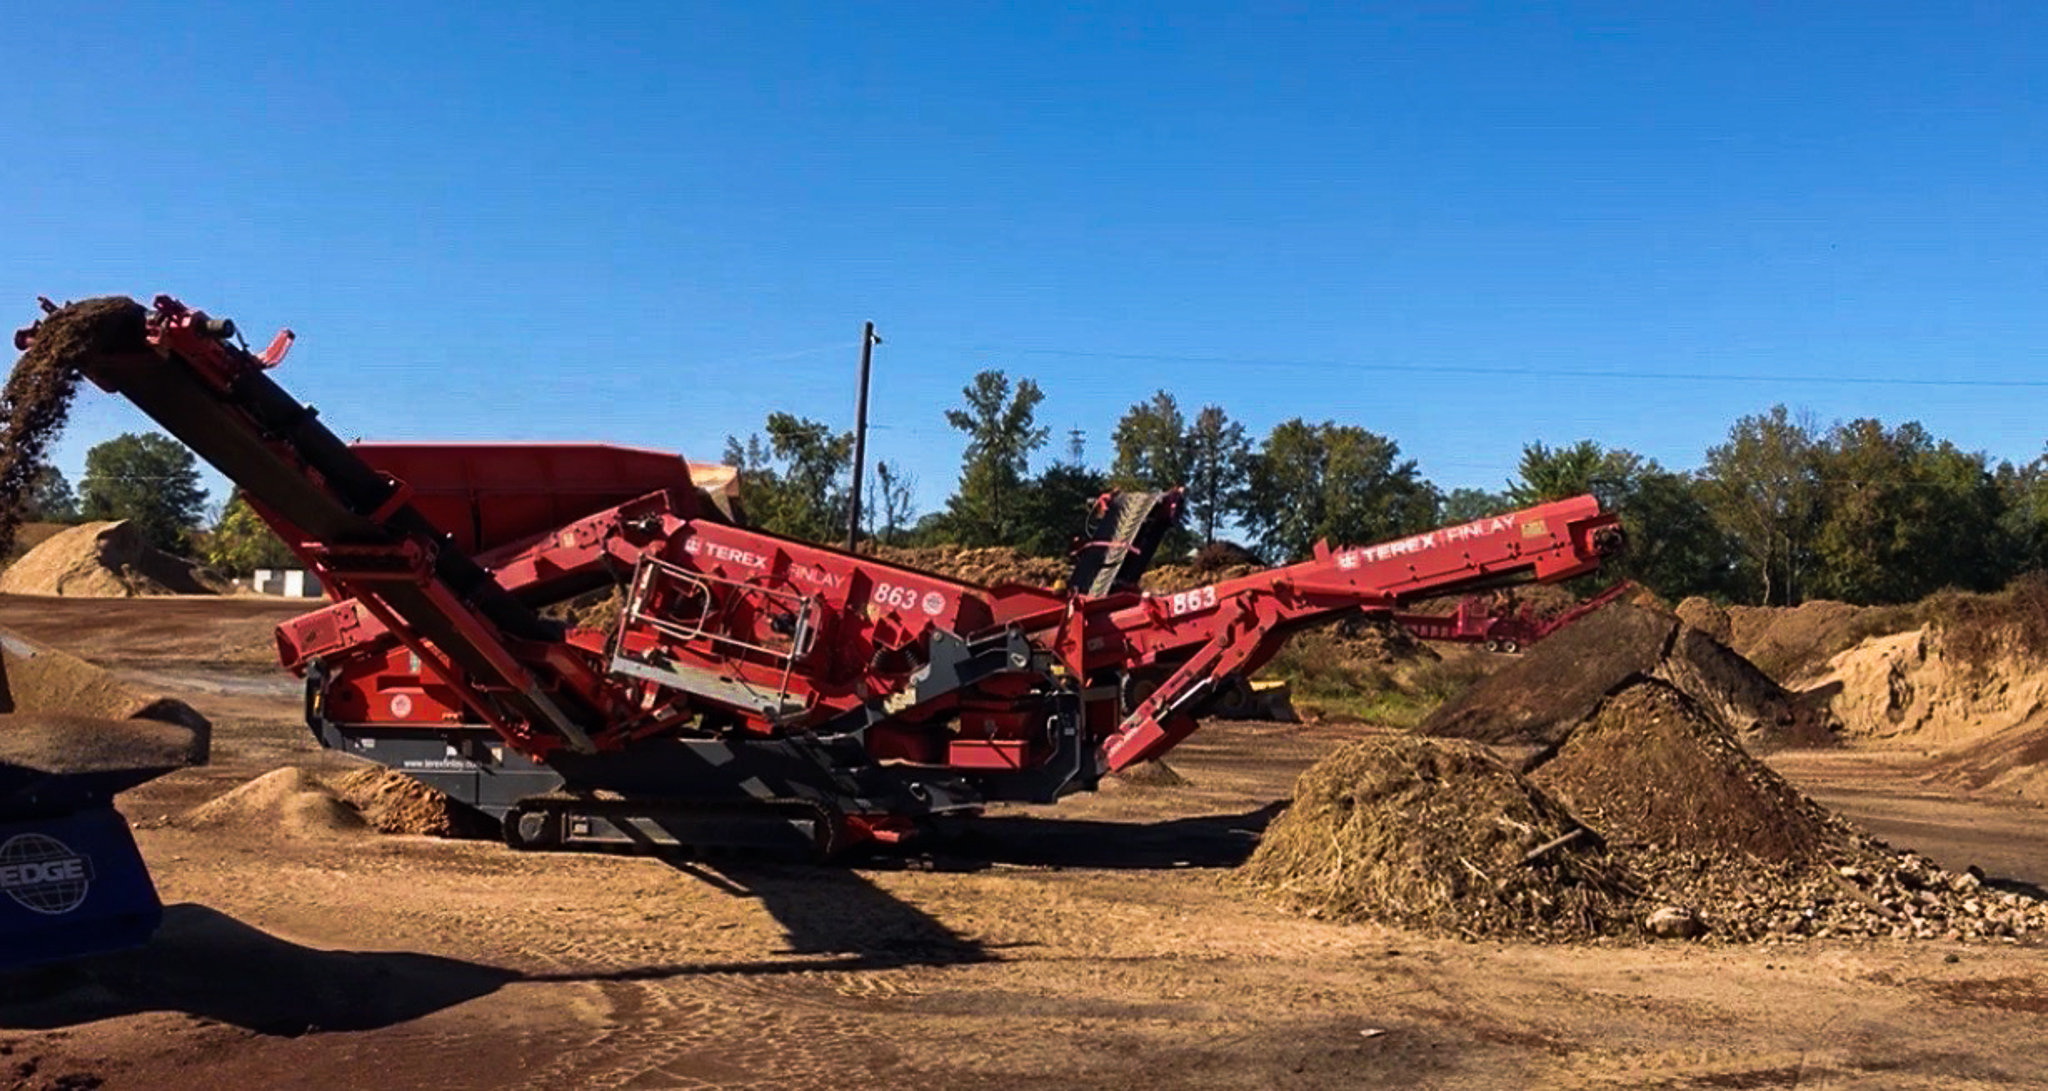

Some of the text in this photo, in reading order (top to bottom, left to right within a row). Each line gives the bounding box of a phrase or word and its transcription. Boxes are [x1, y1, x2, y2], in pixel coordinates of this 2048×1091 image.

[1362, 515, 1516, 563] TEREX FINLAY
[706, 542, 768, 570] TEREX
[874, 582, 918, 610] 863
[1173, 586, 1217, 615] 863
[0, 859, 84, 888] EDGE
